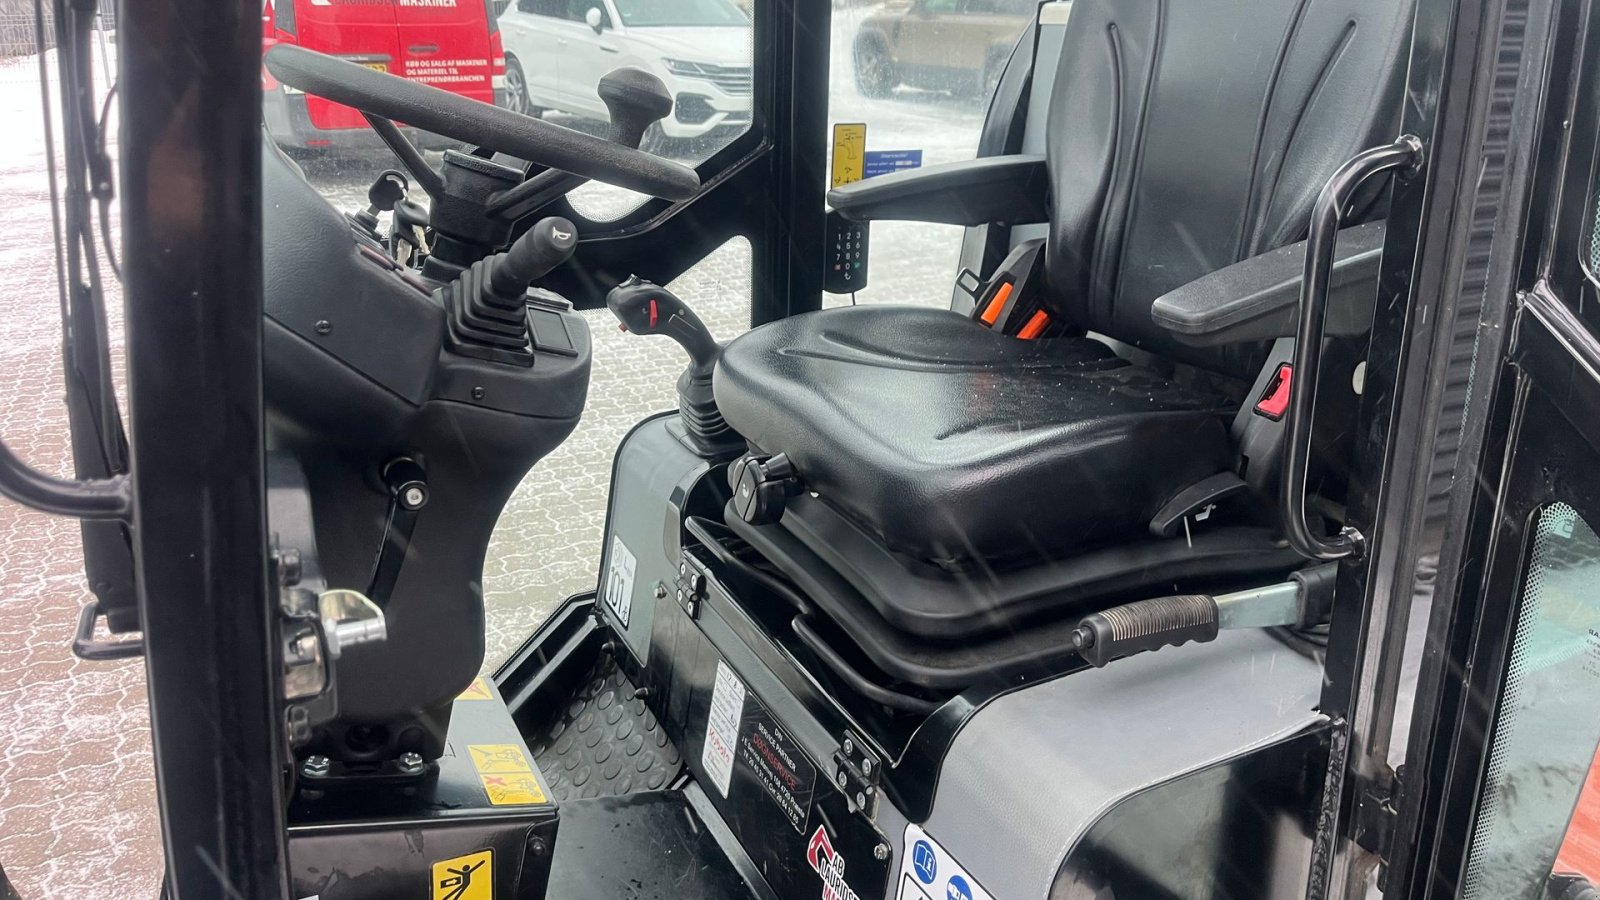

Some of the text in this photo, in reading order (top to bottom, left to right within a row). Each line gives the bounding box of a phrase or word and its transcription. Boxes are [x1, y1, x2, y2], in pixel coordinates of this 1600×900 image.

[608, 566, 624, 614] 101
[758, 722, 797, 772] SERVICE PARTNER
[774, 728, 783, 742] DIN
[820, 858, 860, 900] LAURIDS
[832, 852, 844, 878] AB
